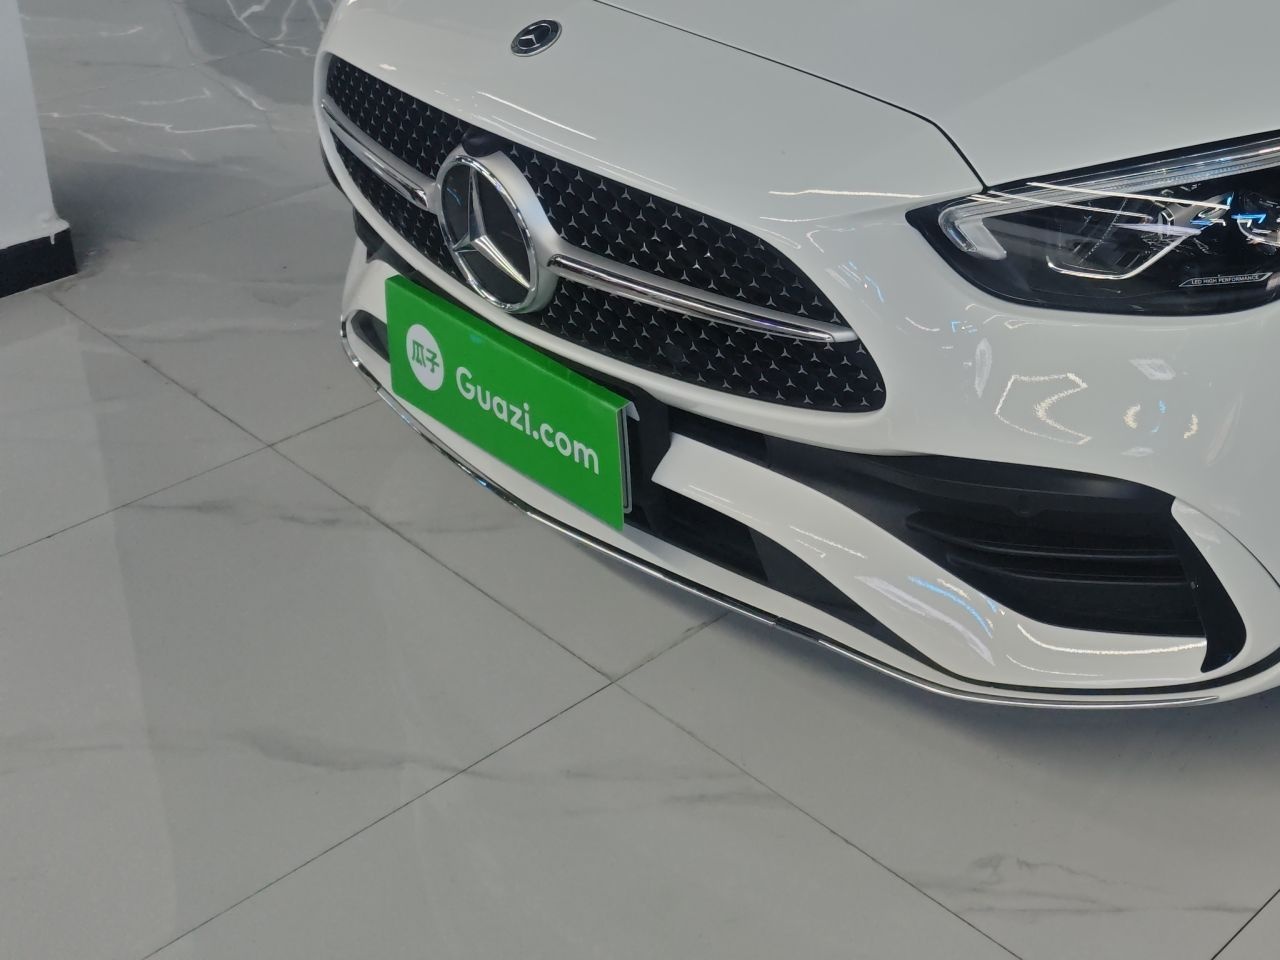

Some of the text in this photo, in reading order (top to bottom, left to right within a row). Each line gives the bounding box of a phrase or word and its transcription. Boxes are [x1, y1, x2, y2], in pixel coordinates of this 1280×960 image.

[1218, 274, 1259, 283] PERFORMANCE
[411, 339, 440, 373] 瓜子
[456, 366, 600, 475] Guazi.com
